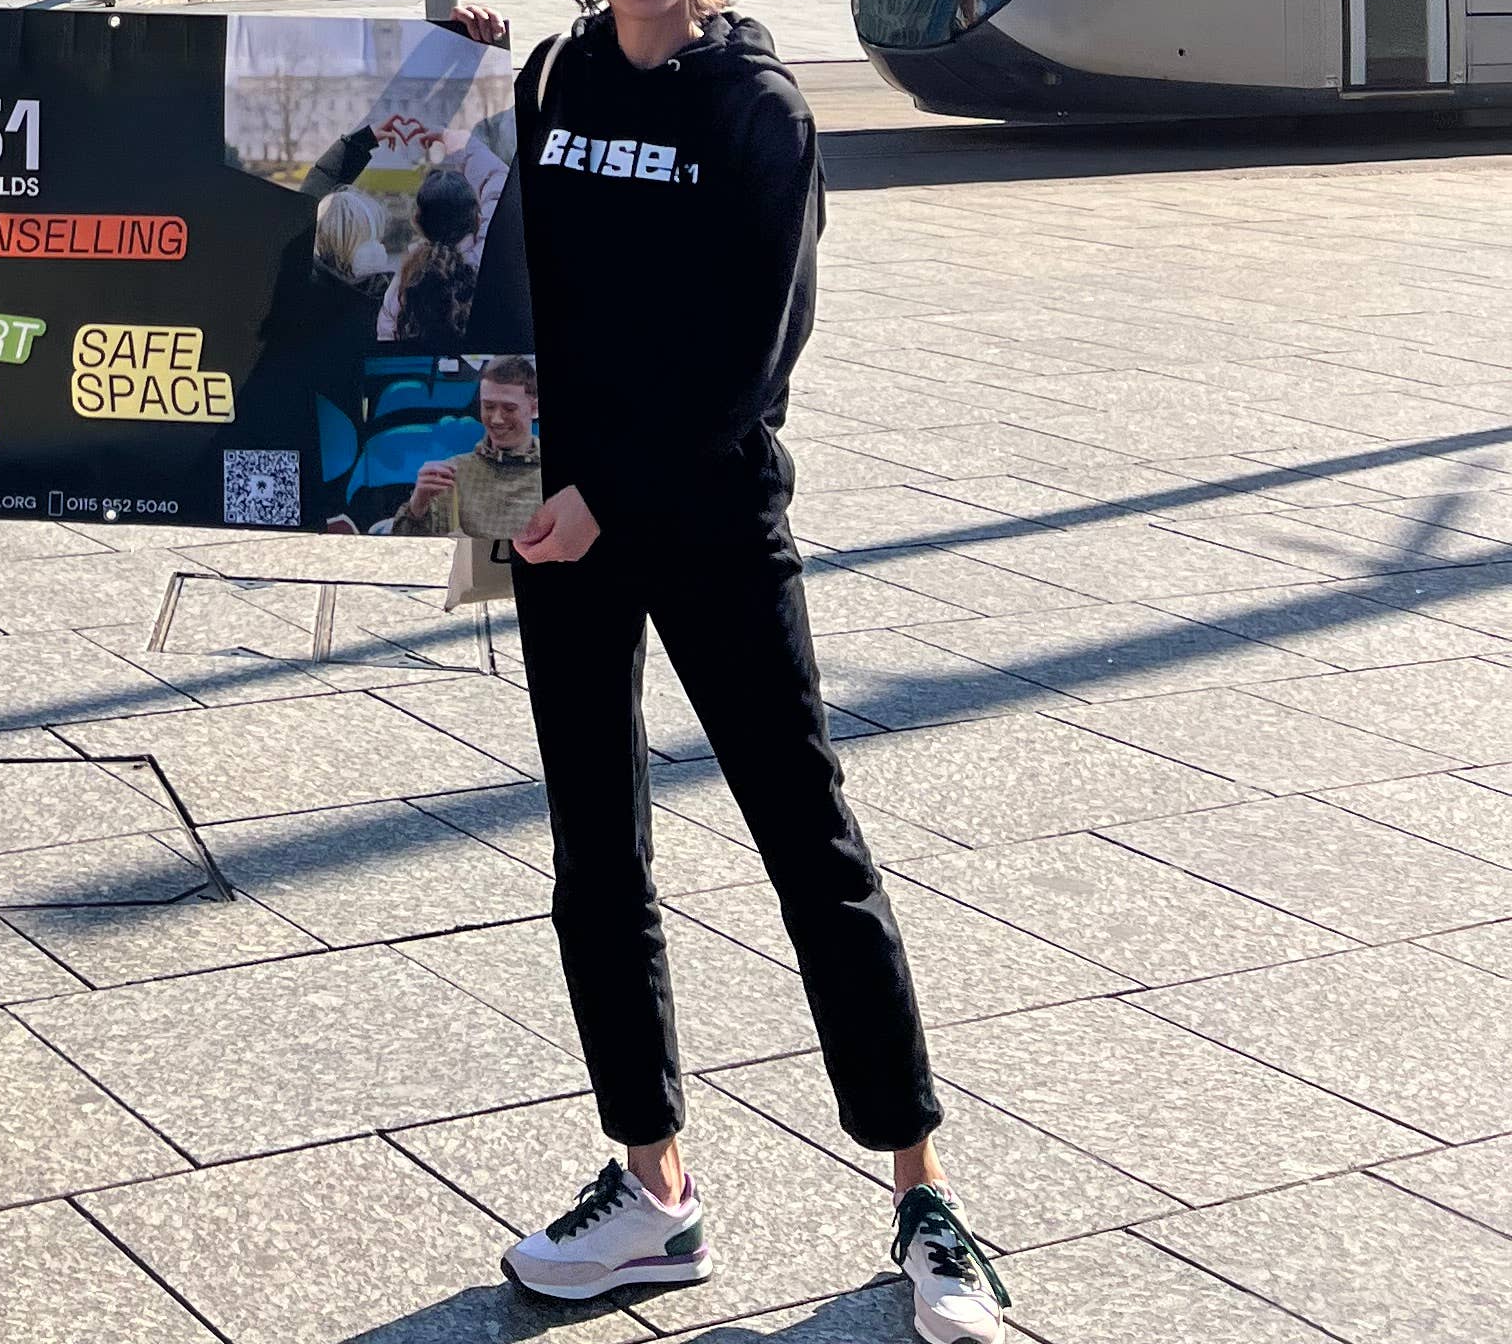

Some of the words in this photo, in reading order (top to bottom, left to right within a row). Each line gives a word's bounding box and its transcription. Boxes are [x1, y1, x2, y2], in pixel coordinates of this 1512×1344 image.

[78, 329, 199, 371] SAFE
[76, 374, 228, 417] SPACE
[66, 497, 97, 512] 0115
[102, 498, 132, 513] 952
[136, 499, 178, 514] 5040
